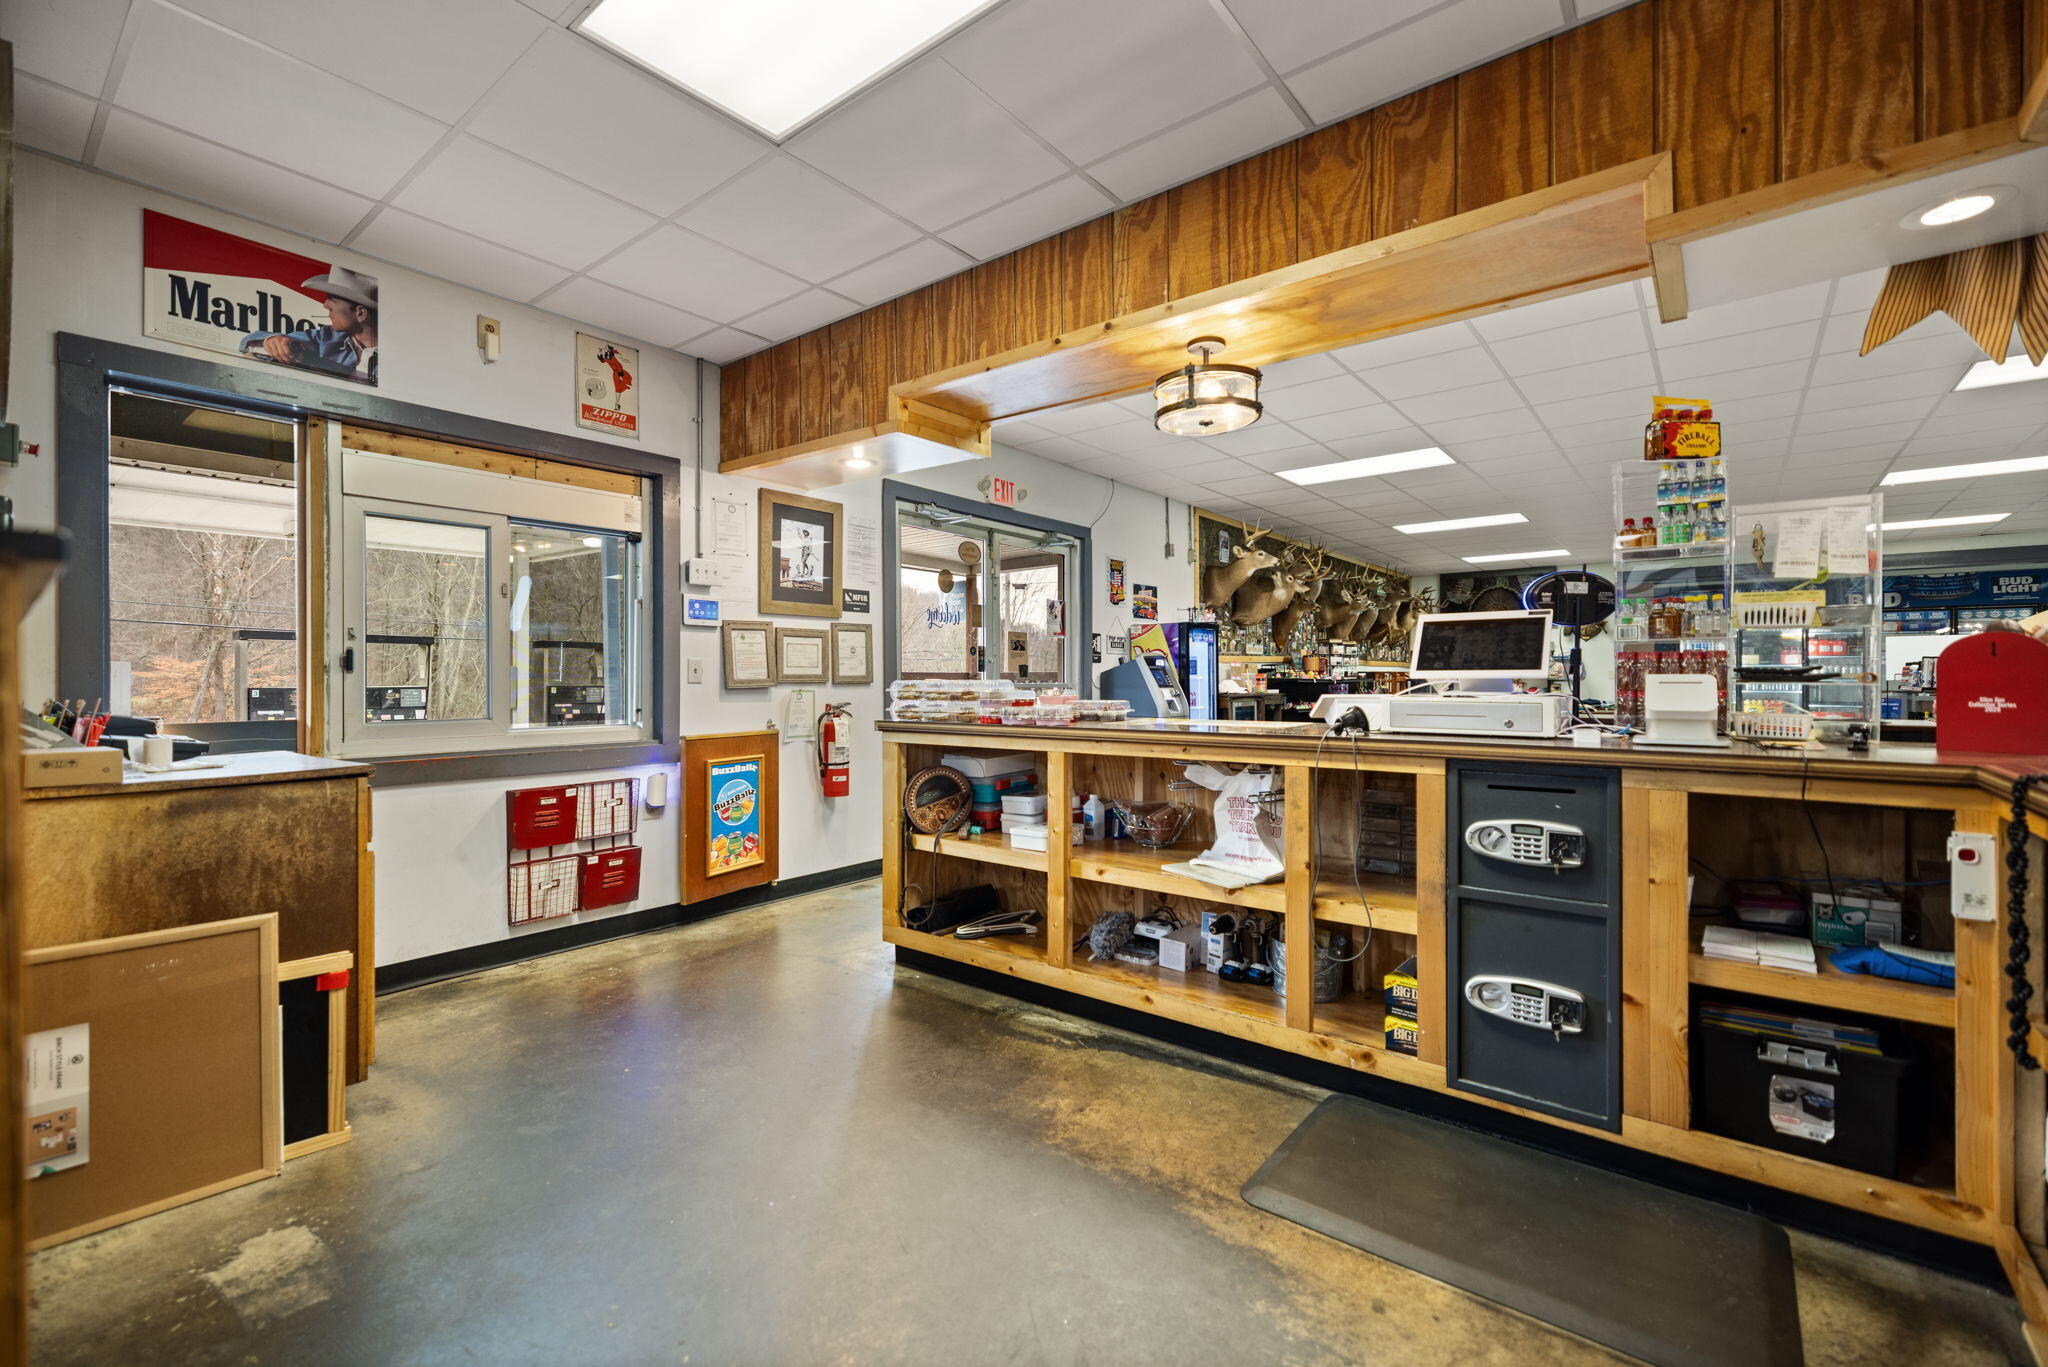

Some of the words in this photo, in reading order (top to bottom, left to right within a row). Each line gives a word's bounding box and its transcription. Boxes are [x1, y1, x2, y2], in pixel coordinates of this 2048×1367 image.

[592, 407, 627, 422] ZIPPO
[1677, 432, 1715, 446] FIREBALL
[994, 477, 1015, 505] EXIT
[1999, 576, 2033, 585] BUD
[1992, 583, 2039, 594] LIGHT
[713, 788, 755, 812] BuzzBallz
[1392, 985, 1411, 998] BIG
[1393, 1028, 1412, 1042] BIG
